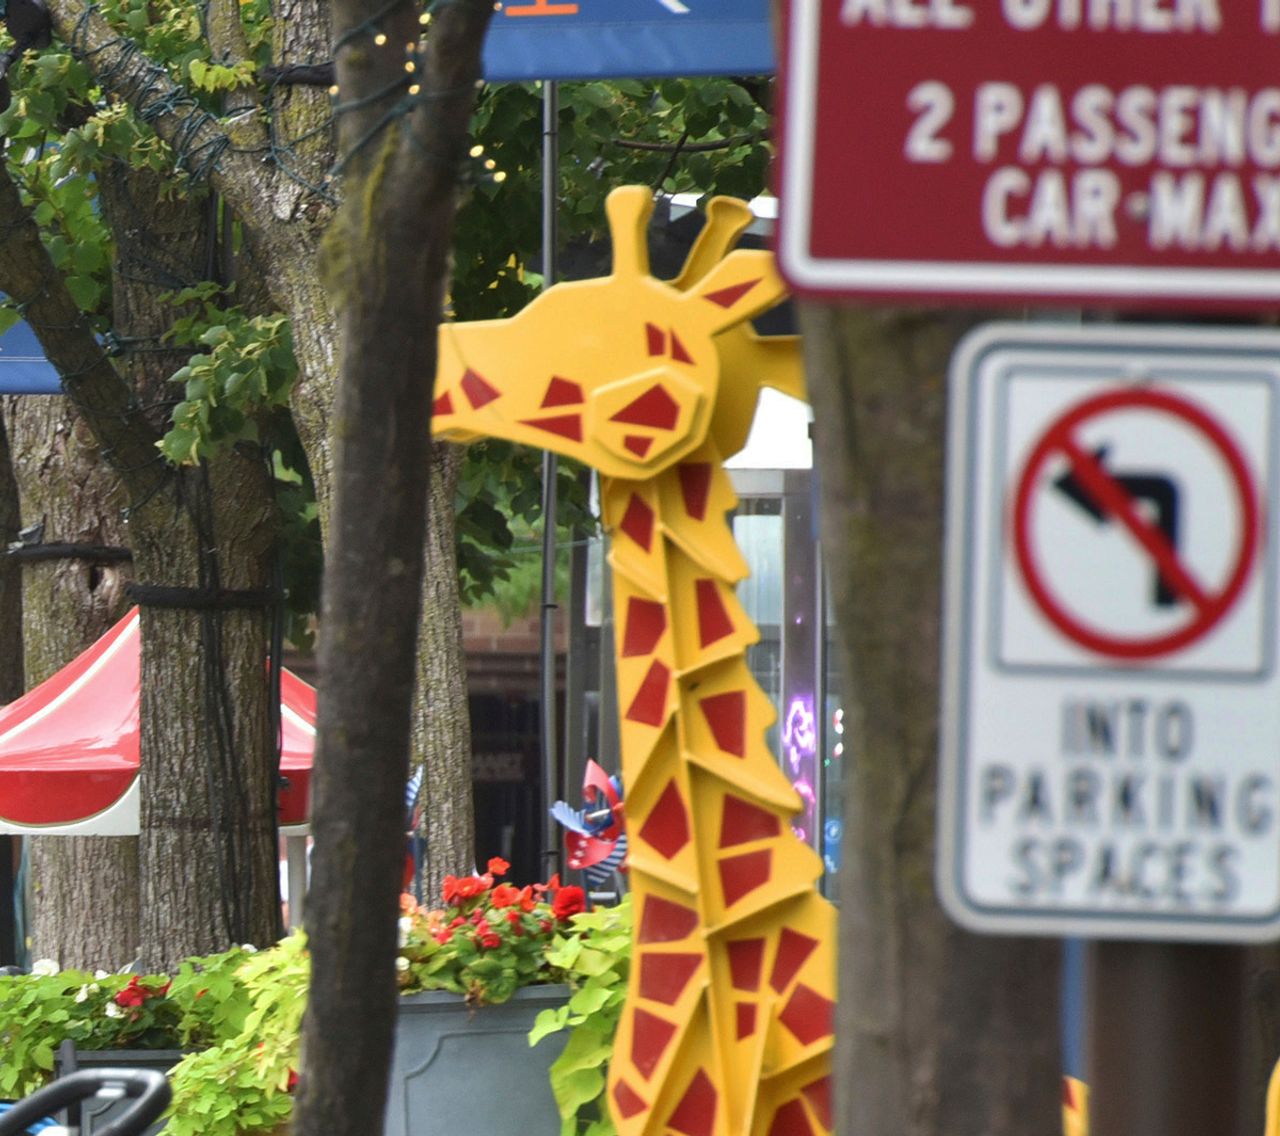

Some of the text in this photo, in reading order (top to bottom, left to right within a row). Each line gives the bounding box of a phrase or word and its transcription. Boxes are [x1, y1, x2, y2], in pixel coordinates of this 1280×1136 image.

[904, 80, 954, 164] 2
[982, 166, 1121, 250] CAR
[1060, 698, 1196, 763] INTO
[979, 764, 1274, 838] PARKING
[1007, 836, 1242, 904] SPACES
